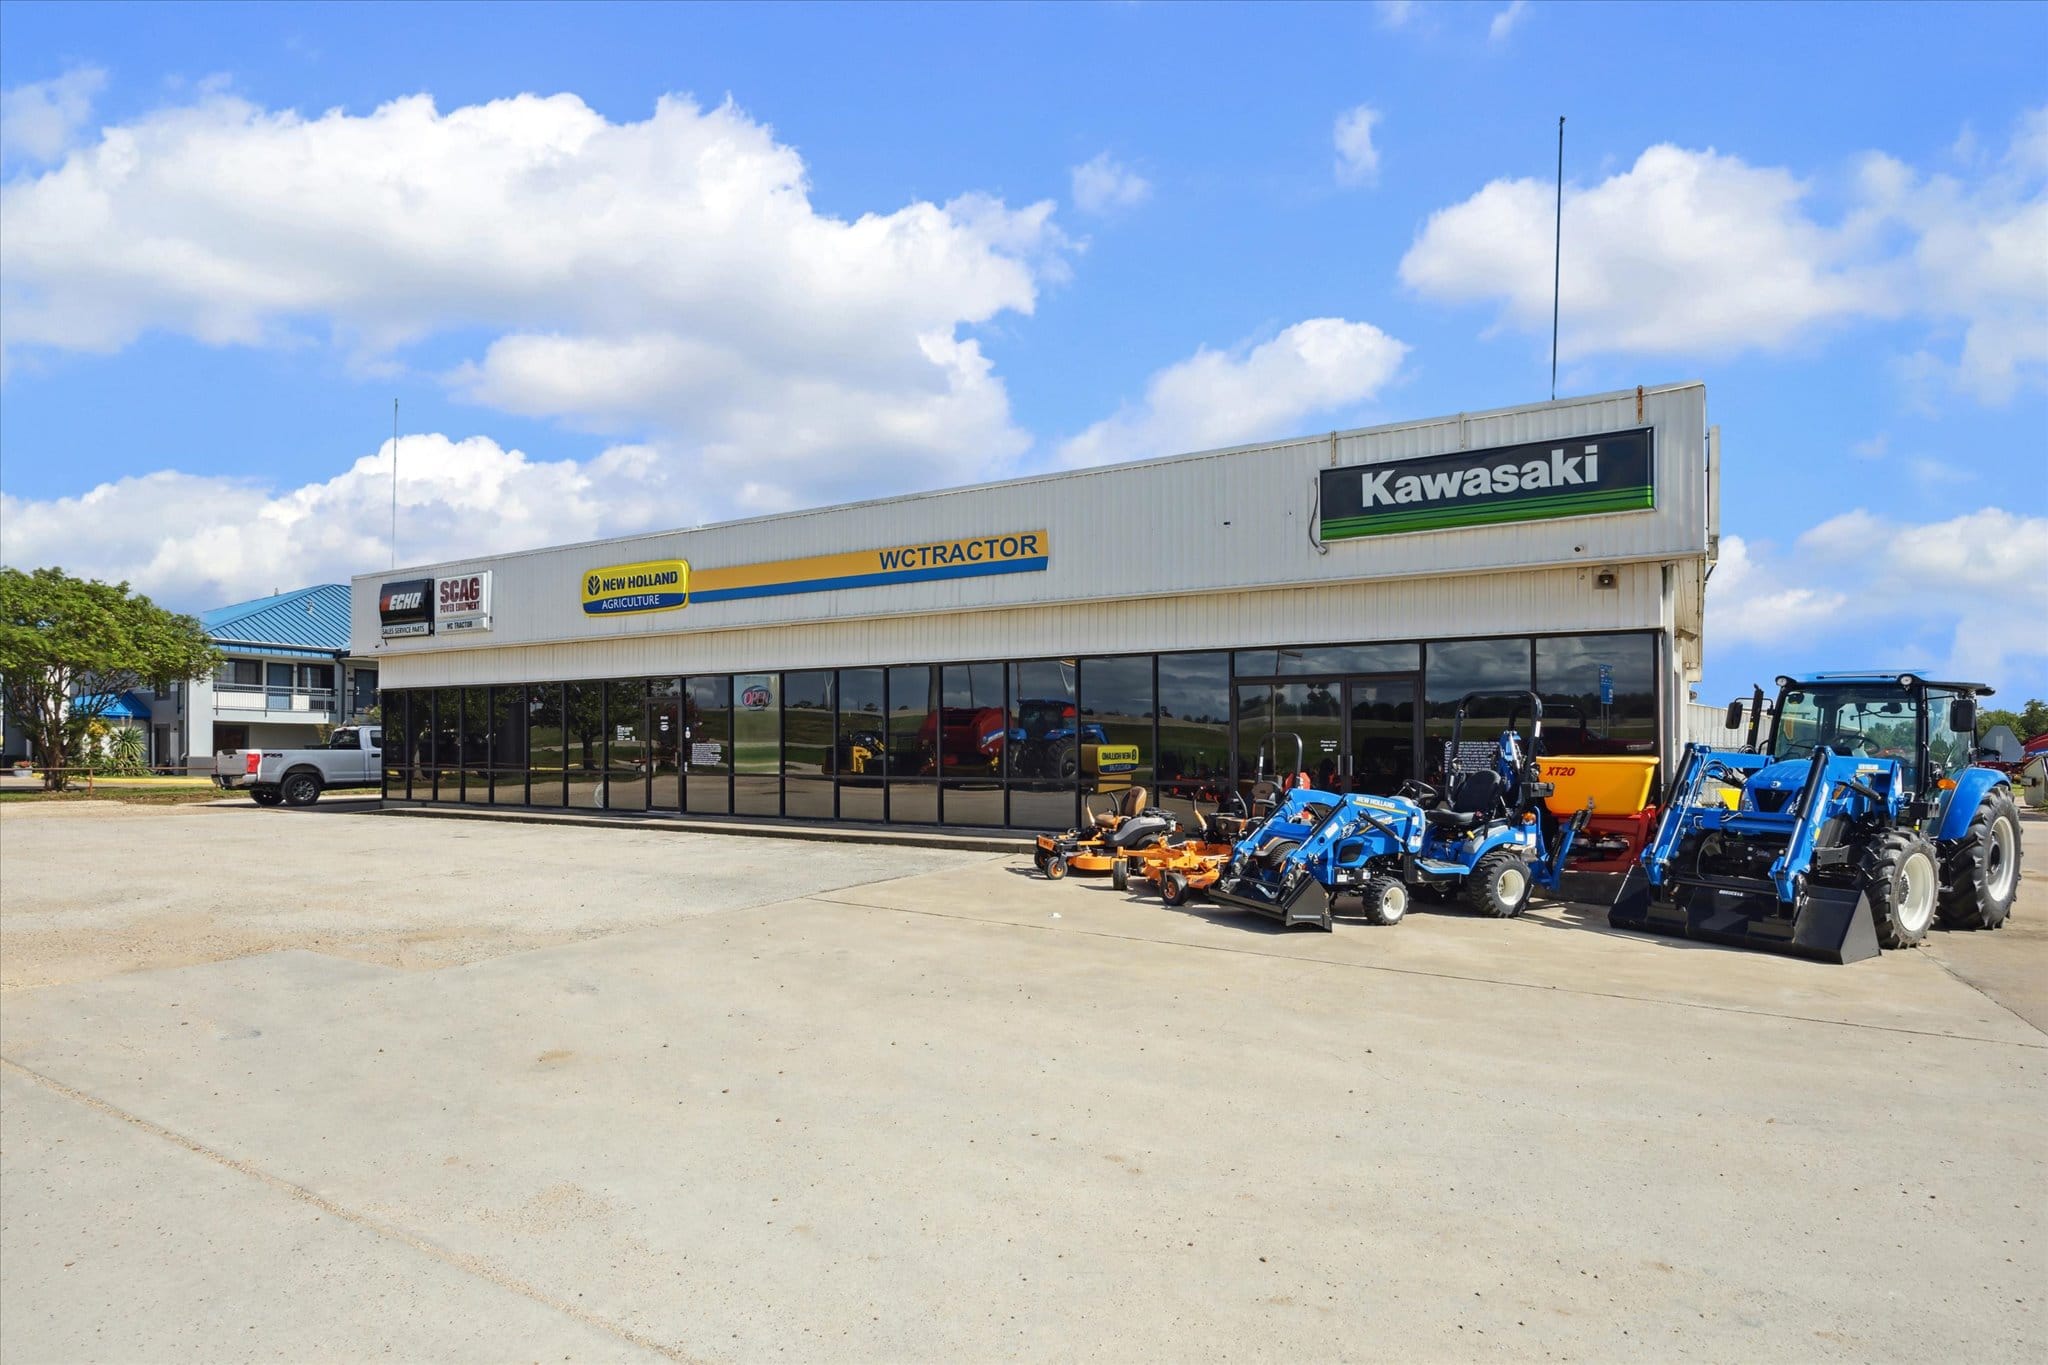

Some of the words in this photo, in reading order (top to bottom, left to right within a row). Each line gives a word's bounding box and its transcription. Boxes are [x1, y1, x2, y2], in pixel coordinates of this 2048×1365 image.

[1361, 444, 1598, 508] Kawasaki
[879, 535, 1039, 570] WCTRACTOR
[602, 577, 625, 592] NEW
[628, 571, 678, 589] HOLLAND
[440, 577, 480, 604] SCAG
[389, 592, 421, 611] ECHO
[440, 603, 455, 614] POWER
[455, 600, 480, 612] EQUIPMENT
[602, 594, 660, 610] AGRICULTURE
[382, 626, 394, 635] SALES
[394, 626, 411, 634] SERVICE
[411, 625, 425, 633] PARTS
[454, 621, 472, 629] TRACTOR
[744, 691, 769, 706] OPEN
[1546, 766, 1576, 776] XT20
[1356, 796, 1370, 805] NEW
[1370, 798, 1396, 809] HOLLAND
